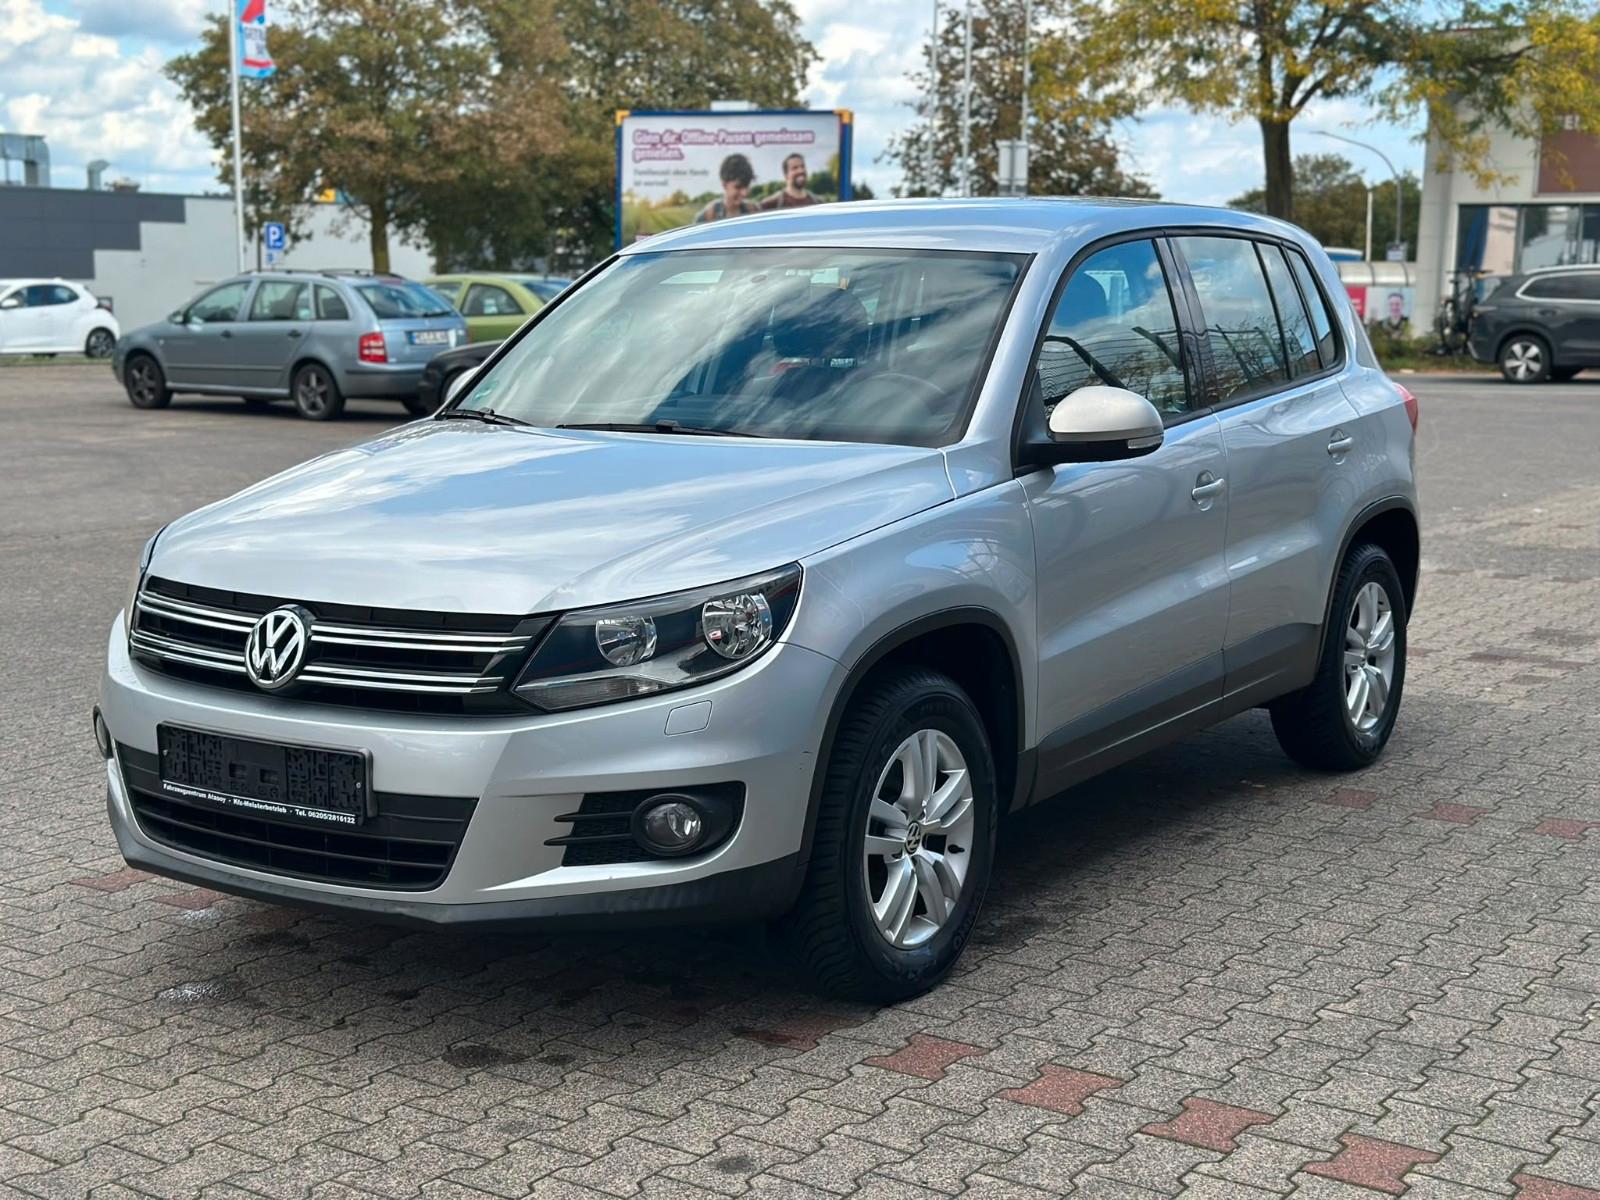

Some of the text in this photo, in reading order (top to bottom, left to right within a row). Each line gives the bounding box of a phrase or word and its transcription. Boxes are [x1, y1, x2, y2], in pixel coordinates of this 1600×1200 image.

[268, 226, 281, 248] P
[249, 613, 302, 682] VW
[163, 783, 207, 799] Fahrzeugzentrum
[294, 808, 306, 817] Tel.
[307, 811, 356, 825] 06205/2816122
